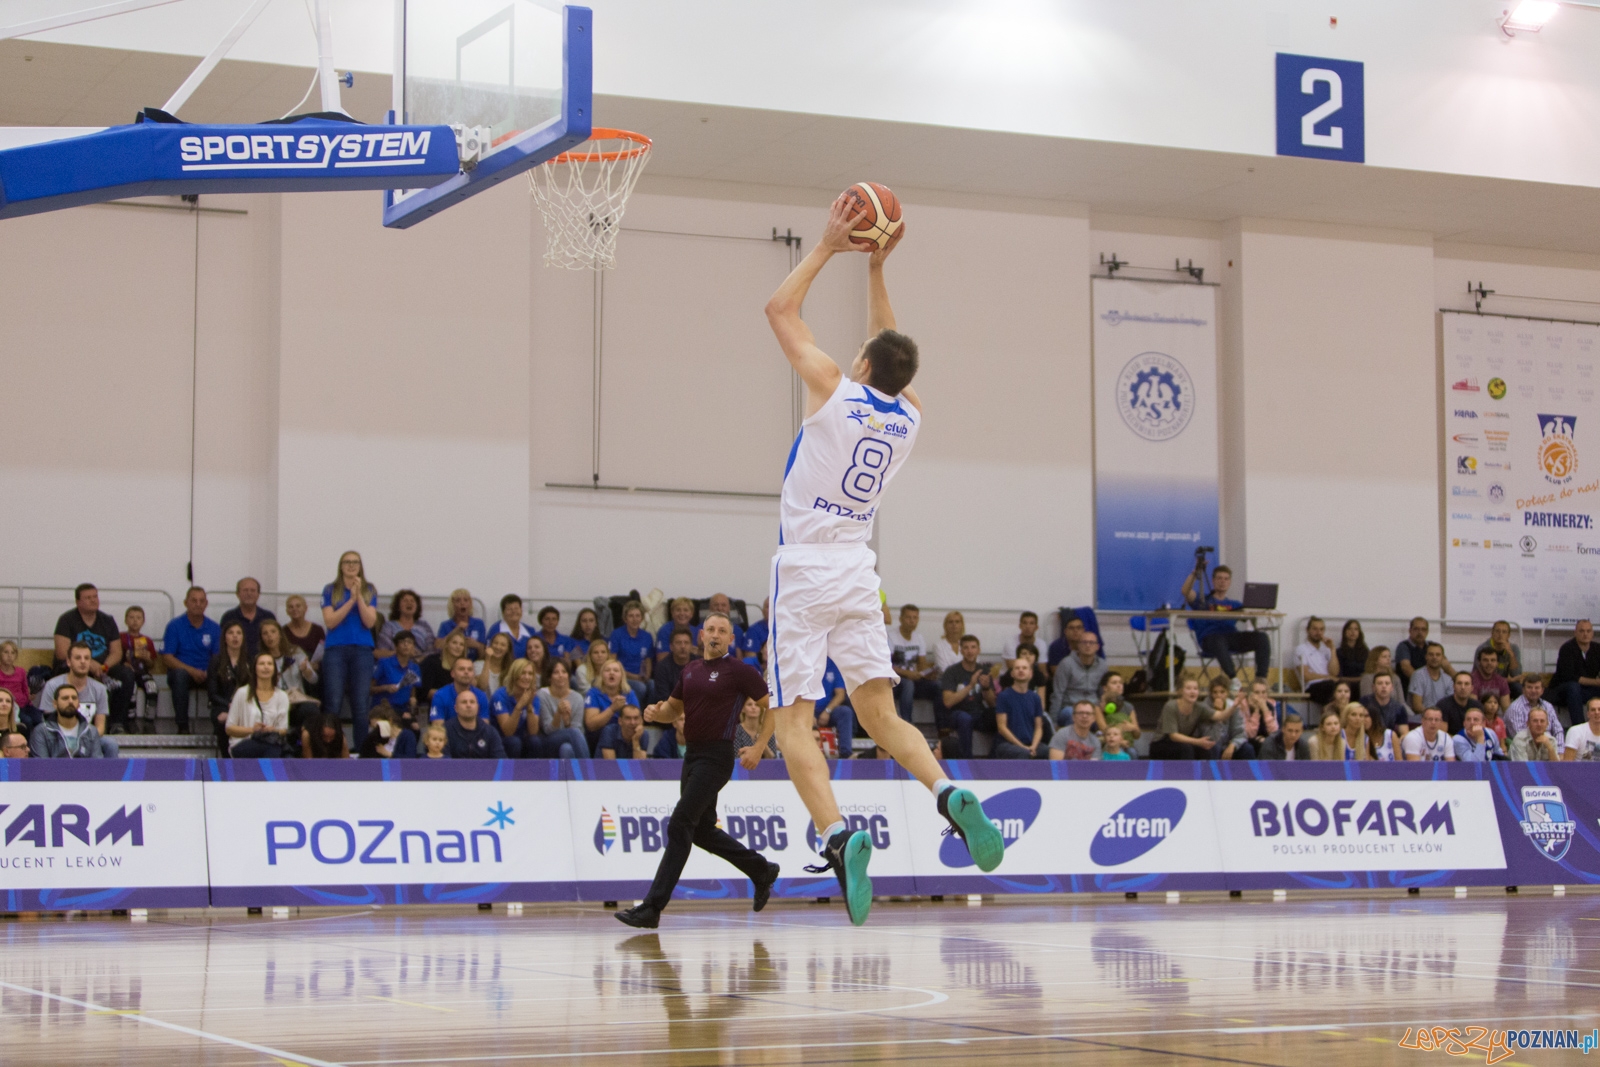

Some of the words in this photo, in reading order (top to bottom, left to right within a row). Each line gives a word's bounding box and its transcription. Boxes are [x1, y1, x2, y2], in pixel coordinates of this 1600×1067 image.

[1301, 68, 1343, 149] 2
[180, 131, 431, 168] SPORTSYSTEM
[842, 437, 893, 503] 8
[1544, 474, 1562, 485] KLUB
[1560, 487, 1574, 499] do
[1524, 511, 1593, 529] PARTNERZY:
[1525, 790, 1558, 798] BIOFARM
[724, 803, 785, 815] fundacja
[1250, 798, 1456, 837] BIOFARM
[0, 803, 144, 847] ARM
[726, 815, 788, 851] PBG
[1102, 813, 1171, 838] atrem
[1521, 822, 1575, 834] BASKET
[1273, 844, 1316, 854] POLSKI
[1324, 843, 1396, 854] PRODUCENT
[1403, 841, 1443, 853] LEKÓW
[66, 853, 122, 868] LEKÓW
